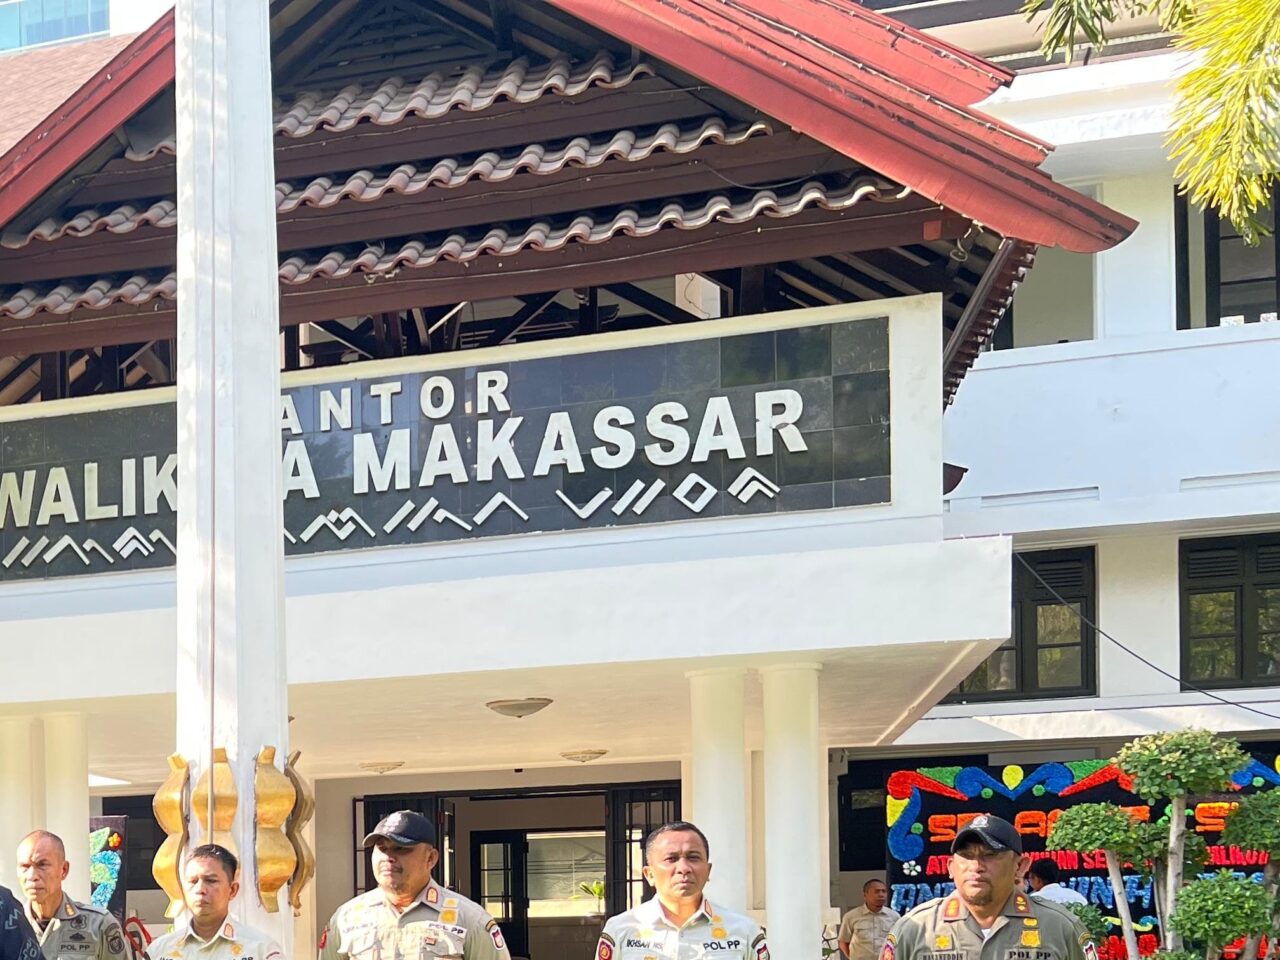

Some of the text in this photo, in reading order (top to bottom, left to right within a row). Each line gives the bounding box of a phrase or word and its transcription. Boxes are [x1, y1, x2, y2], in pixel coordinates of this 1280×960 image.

[280, 370, 511, 435] ANTOR
[353, 389, 809, 494] MAKASSAR
[428, 922, 464, 935] POL PP
[703, 940, 741, 951] POL PP
[1008, 951, 1052, 960] POL PP
